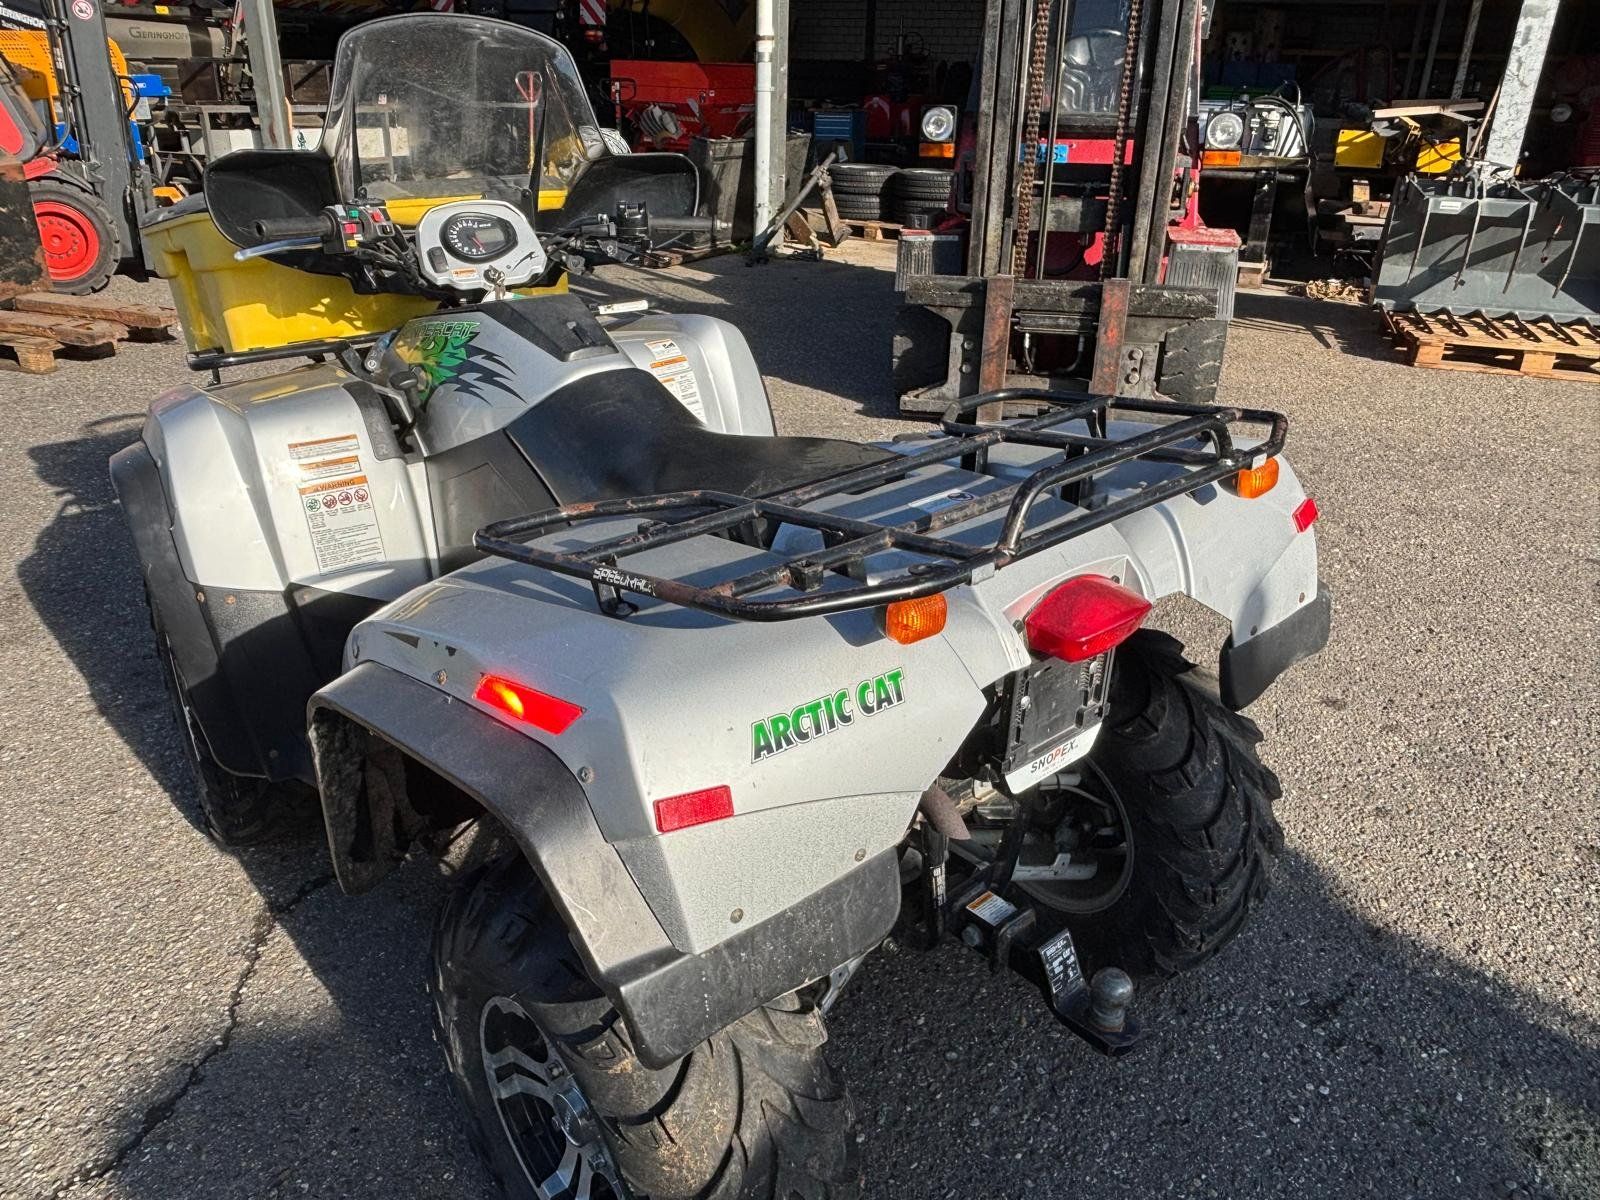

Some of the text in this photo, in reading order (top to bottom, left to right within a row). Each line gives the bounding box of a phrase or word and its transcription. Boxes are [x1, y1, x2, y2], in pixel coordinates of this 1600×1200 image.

[751, 667, 905, 764] ARCTIC CAT
[1030, 739, 1076, 773] SNOPEX
